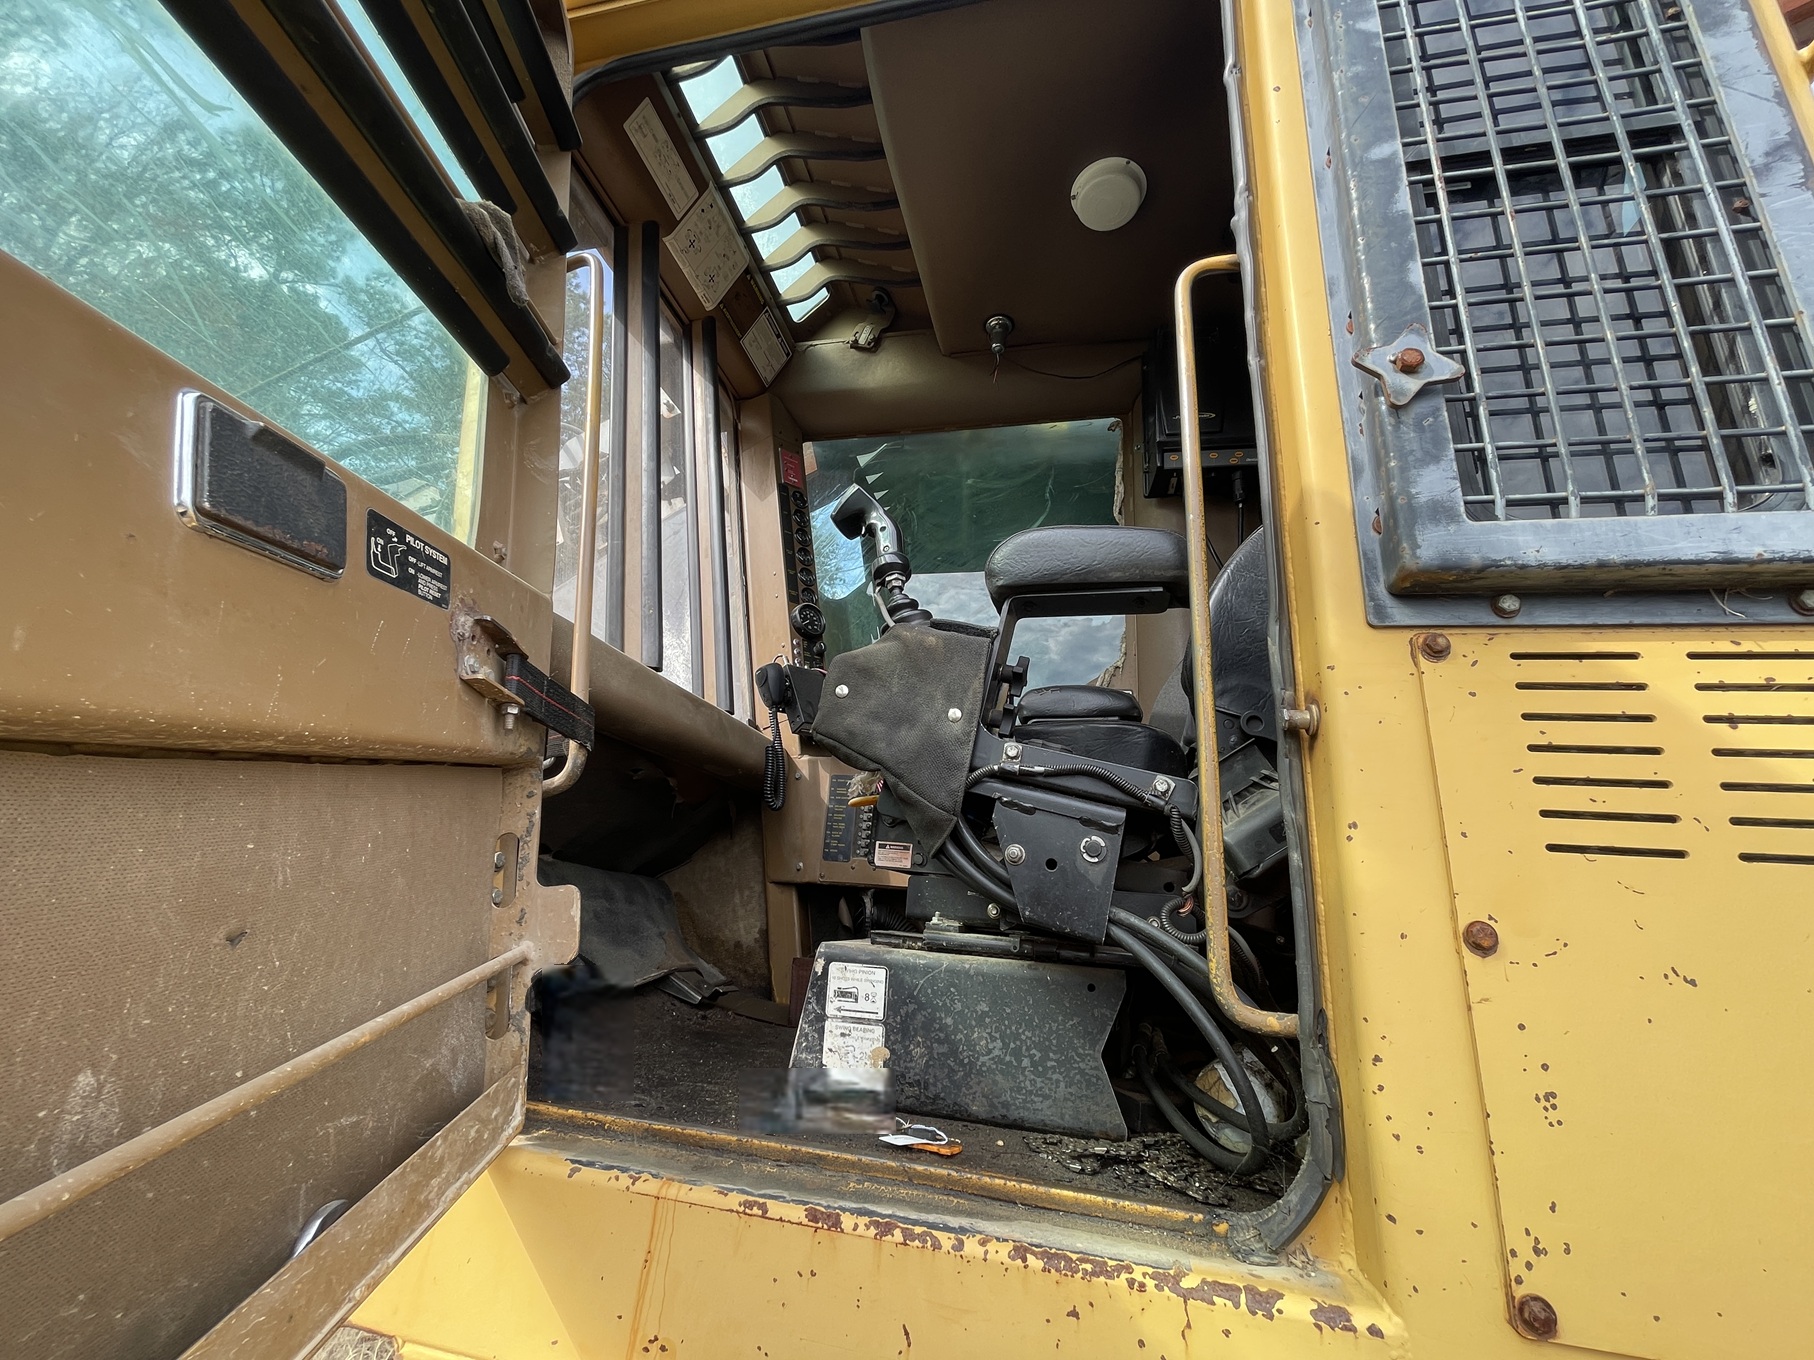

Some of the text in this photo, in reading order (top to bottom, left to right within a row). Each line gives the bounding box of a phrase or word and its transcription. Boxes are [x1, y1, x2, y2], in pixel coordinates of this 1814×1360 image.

[386, 528, 396, 537] OFF
[376, 537, 384, 545] ON
[405, 534, 448, 566] PILOT SYSTEM
[408, 555, 417, 564] OFF
[864, 992, 870, 1001] 8
